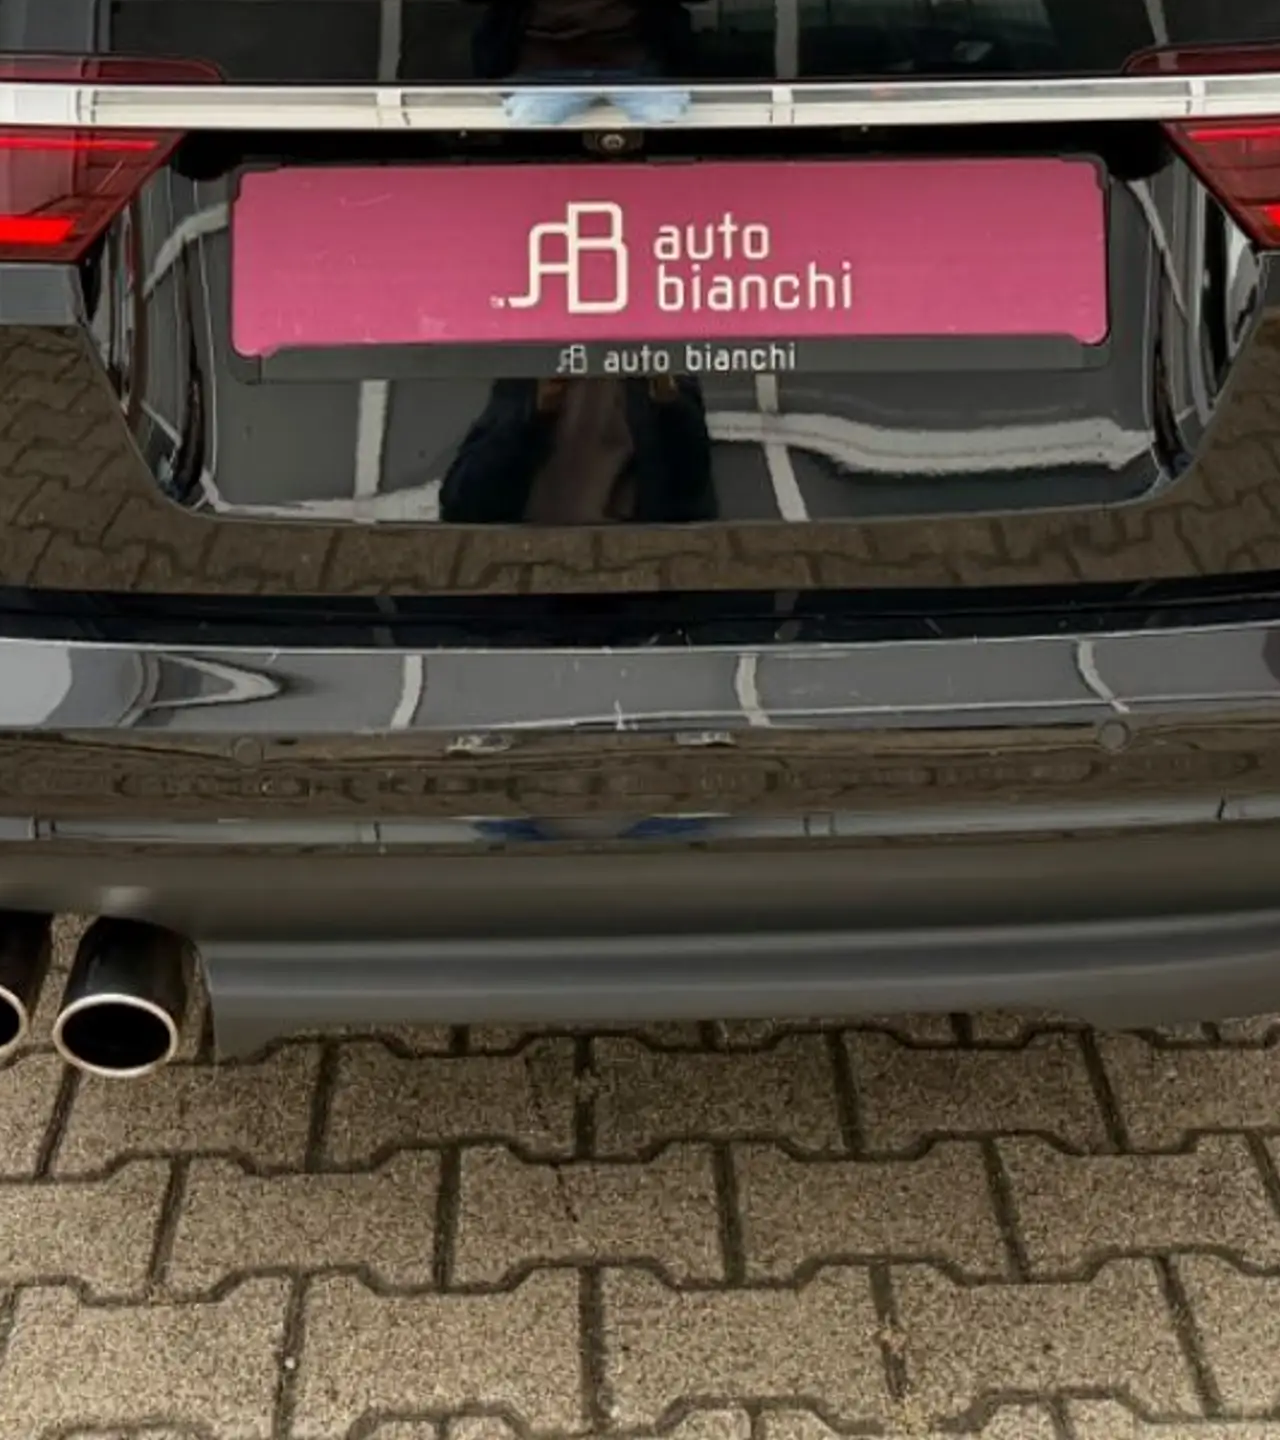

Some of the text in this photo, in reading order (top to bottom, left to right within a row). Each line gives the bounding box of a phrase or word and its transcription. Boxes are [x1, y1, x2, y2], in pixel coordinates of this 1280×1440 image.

[653, 212, 771, 261] auto
[657, 261, 853, 312] bianchi
[604, 345, 670, 372] auto
[685, 343, 796, 371] bianchi
